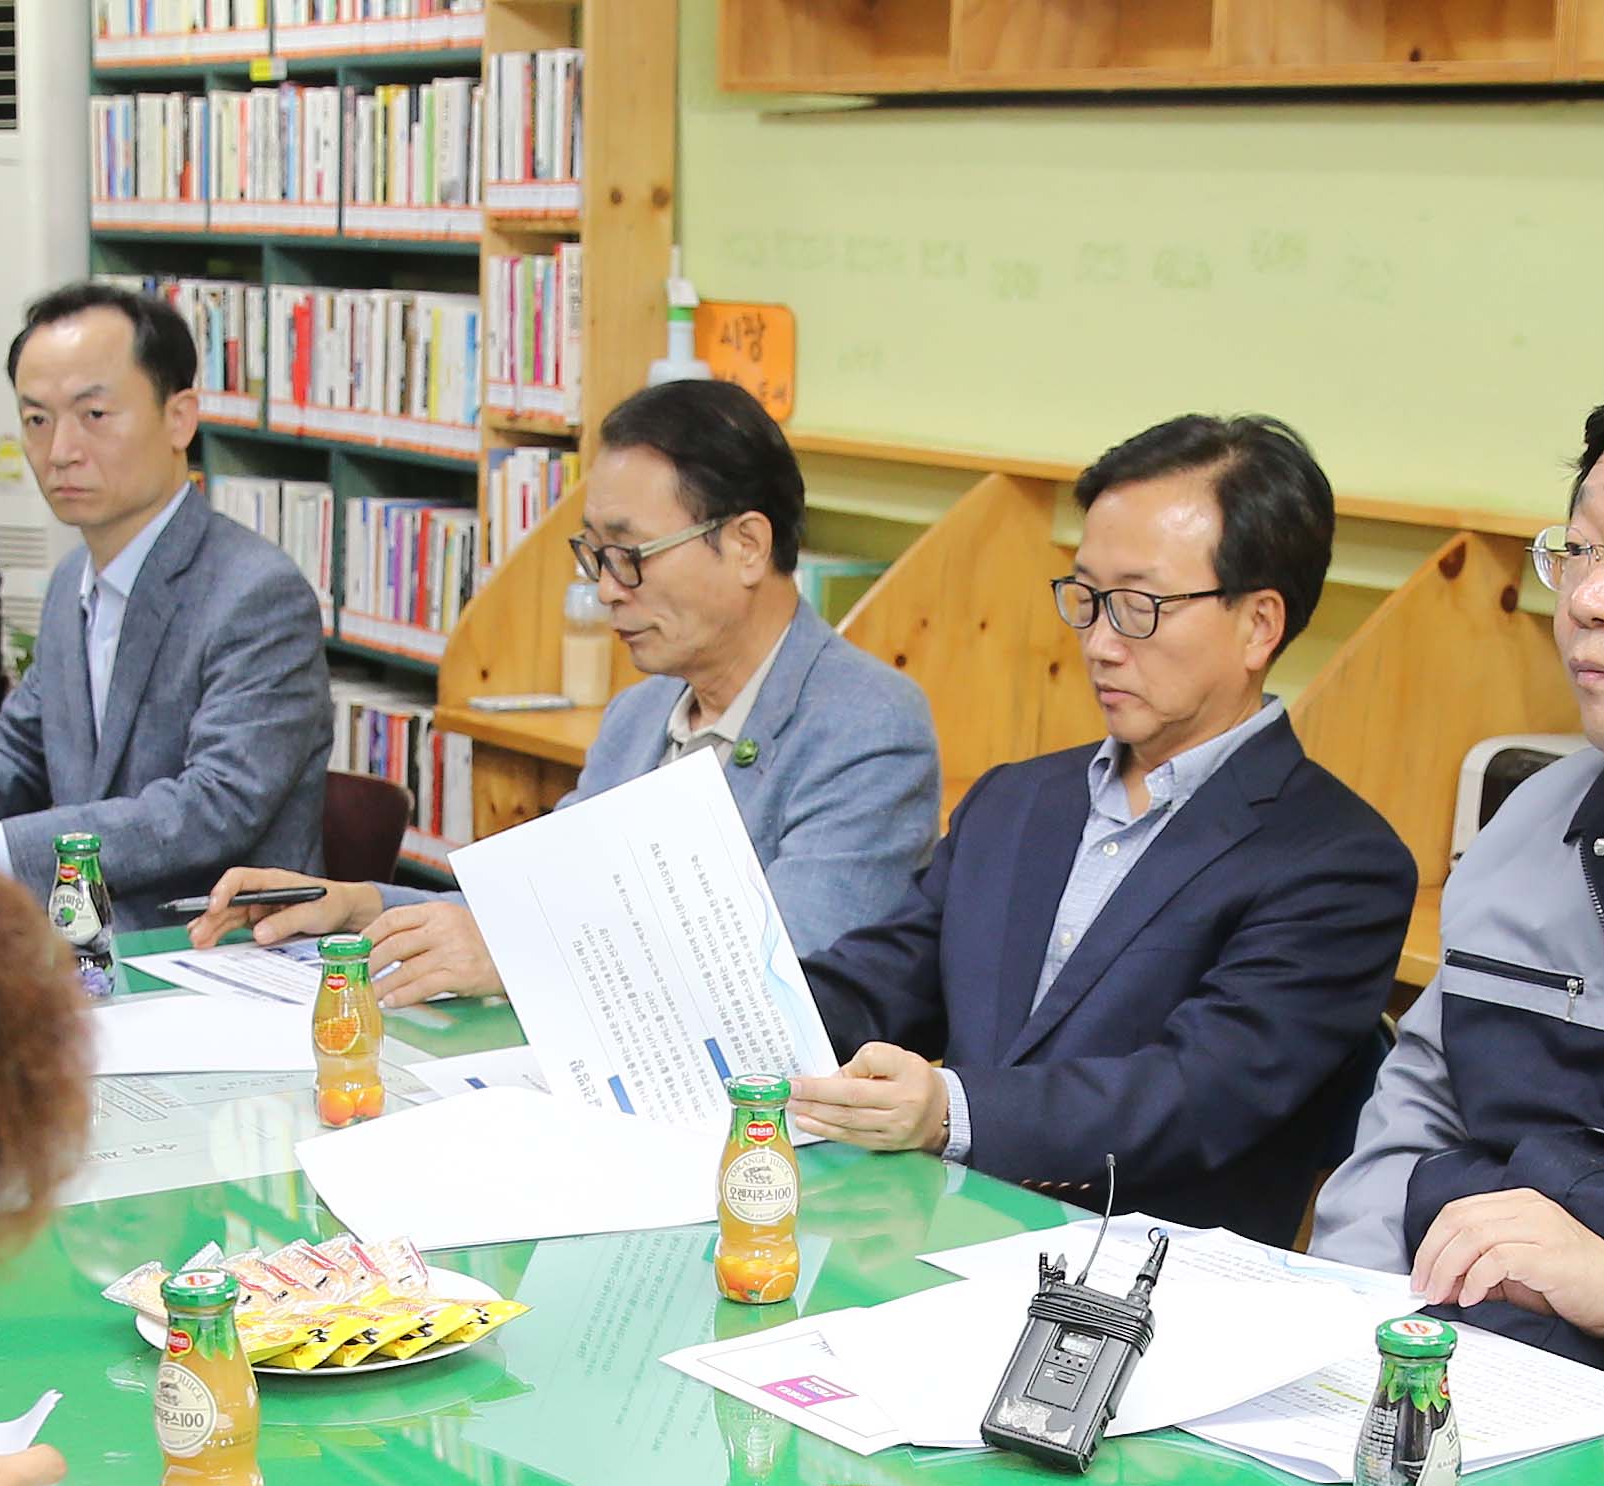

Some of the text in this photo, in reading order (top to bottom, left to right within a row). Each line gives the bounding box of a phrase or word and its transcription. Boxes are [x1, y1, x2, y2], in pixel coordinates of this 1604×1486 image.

[730, 1155, 791, 1179] ORANGE JUICE
[729, 1185, 792, 1202] 오렌지주스100
[178, 1371, 207, 1403] JUICE
